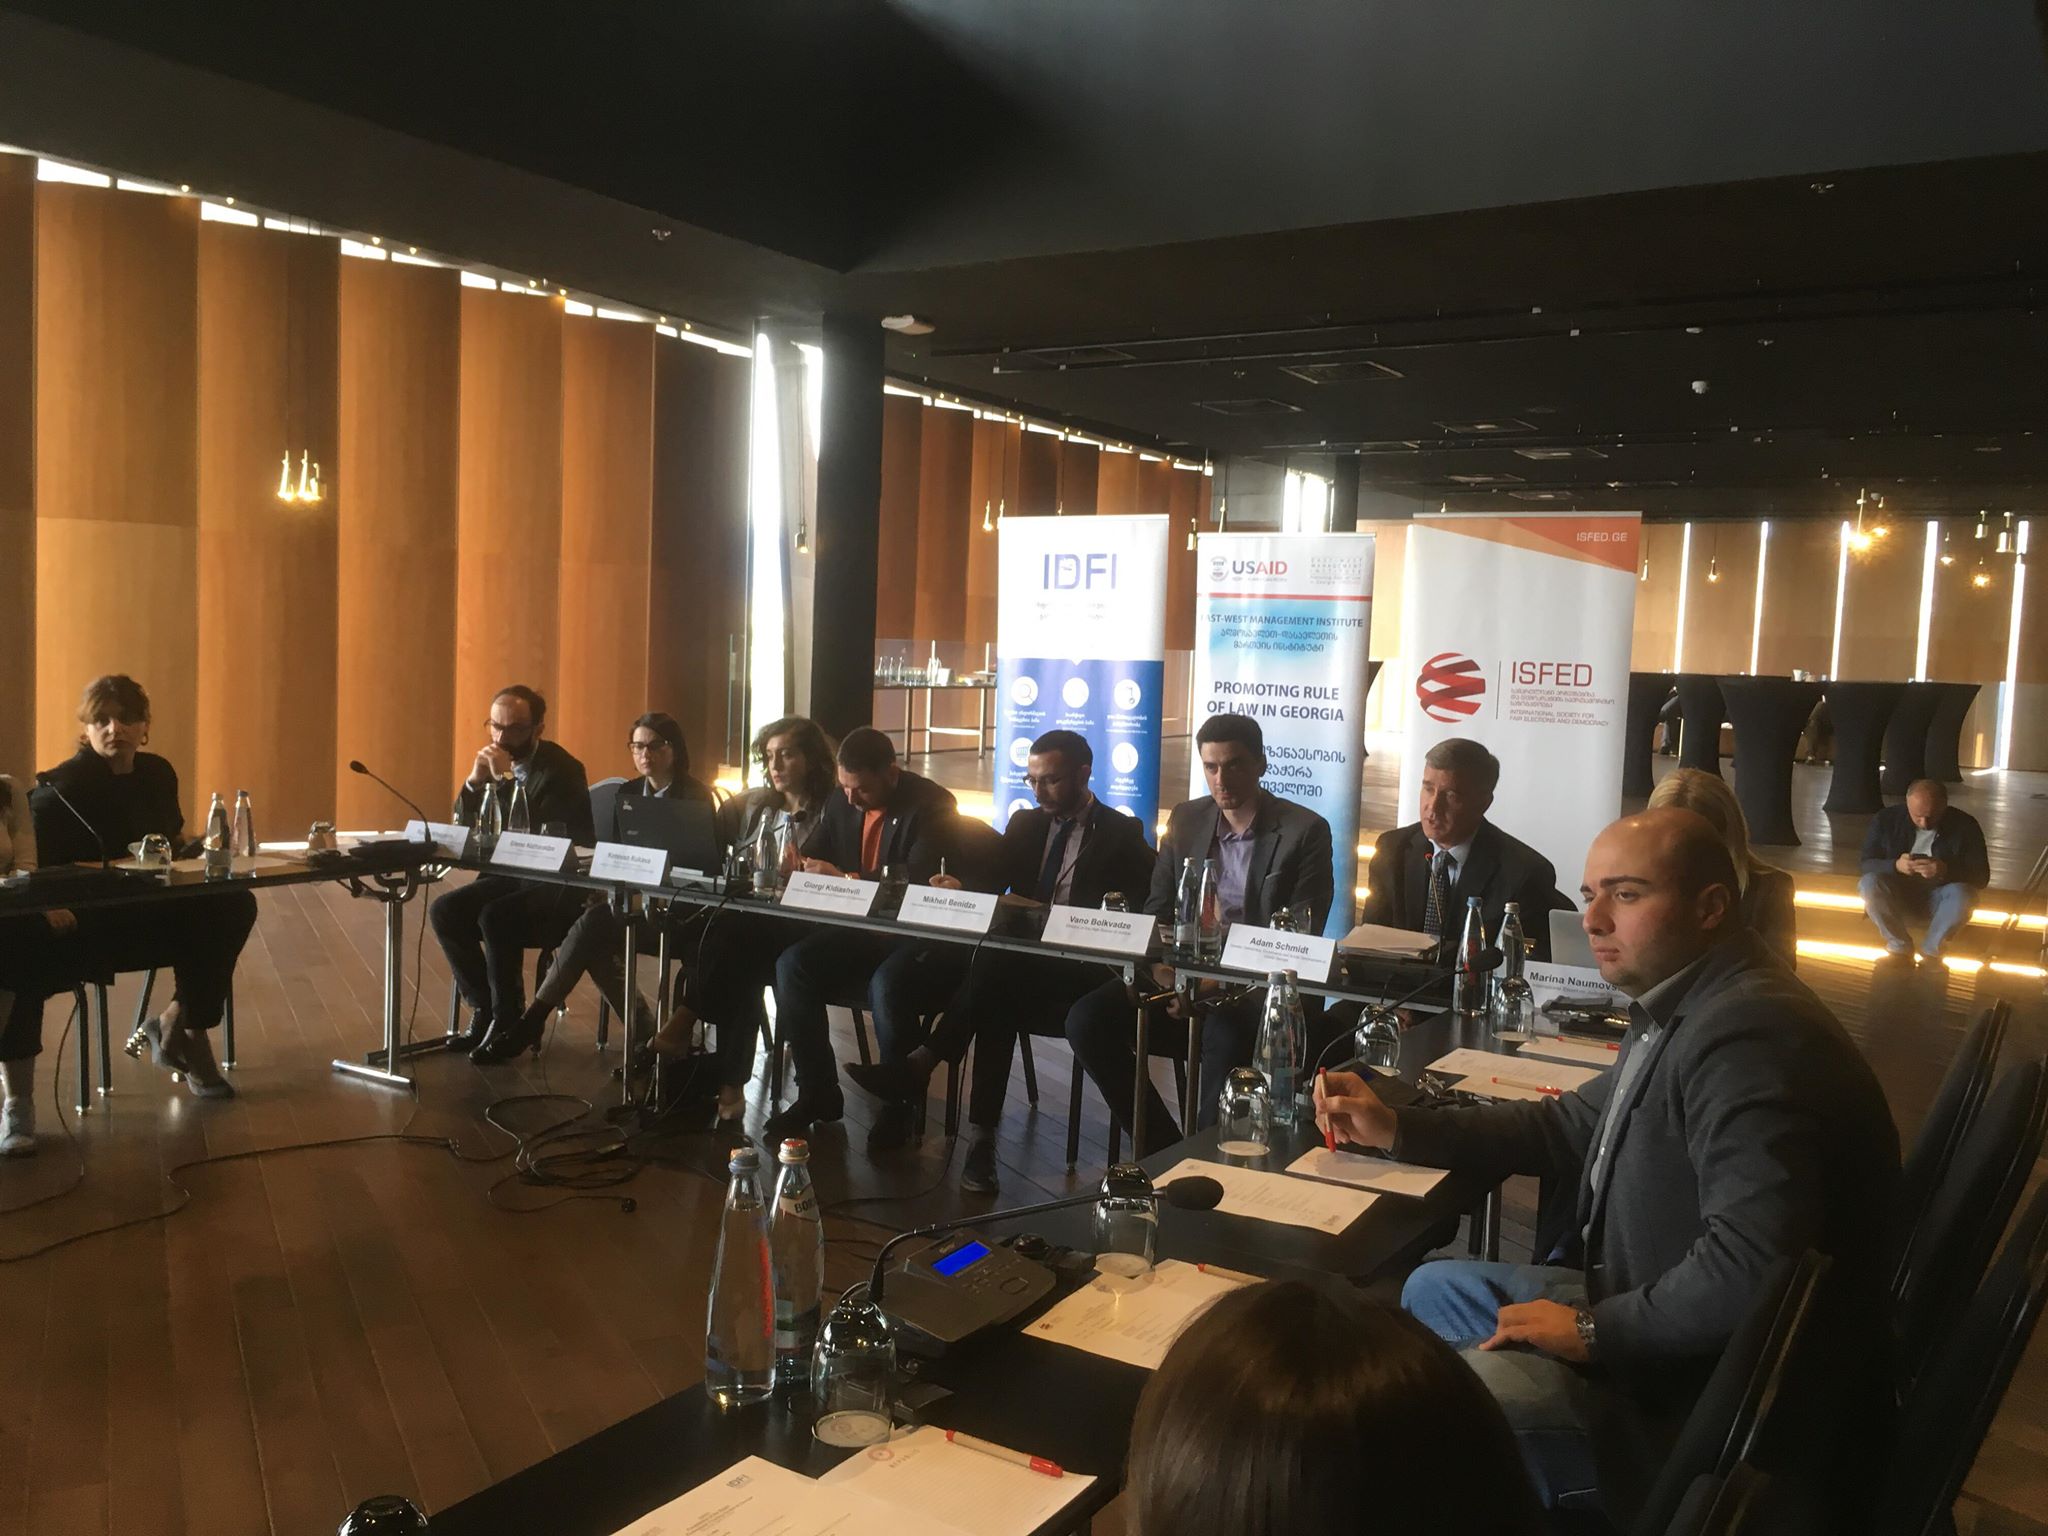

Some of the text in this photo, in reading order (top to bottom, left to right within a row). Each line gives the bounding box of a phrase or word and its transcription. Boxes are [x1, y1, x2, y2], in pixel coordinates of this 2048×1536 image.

[1576, 531, 1628, 542] ISFED.GE
[1043, 553, 1117, 590] IDFI
[1232, 560, 1288, 575] USAID
[1201, 613, 1363, 628] ST-WEST MANAGEMENT INSTITUTE
[1511, 661, 1592, 687] ISFED
[1214, 681, 1339, 700] PROMOTING RULE
[1207, 700, 1344, 721] OF LAW IN GEORGIA
[1263, 745, 1346, 763] ზენაესობის
[804, 881, 825, 891] Giorgi
[923, 895, 947, 906] Mikheil
[948, 898, 976, 910] Benidze
[1070, 915, 1089, 925] Vano
[1091, 918, 1131, 930] Bolkvadze
[1250, 937, 1309, 954] Adam Schmidt
[1529, 971, 1620, 991] Marina Naumovs
